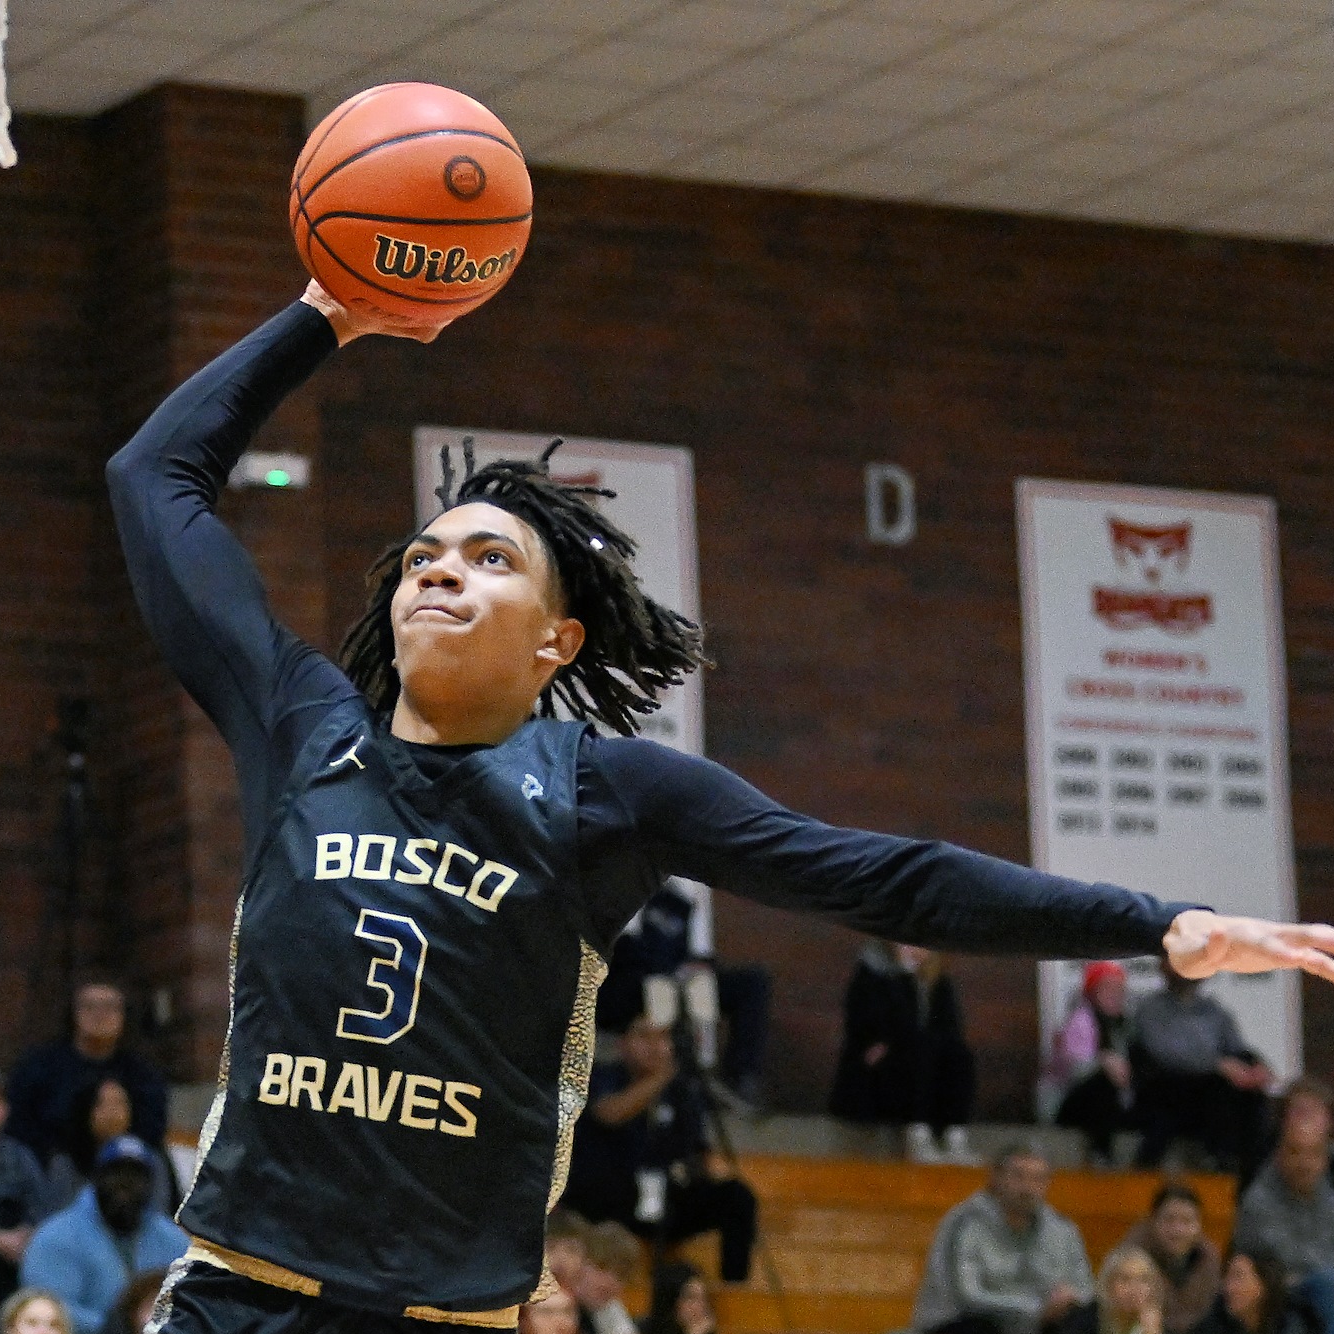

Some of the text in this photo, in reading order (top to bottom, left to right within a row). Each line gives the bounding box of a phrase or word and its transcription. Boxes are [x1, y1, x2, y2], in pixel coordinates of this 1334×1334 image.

[373, 233, 517, 287] Wilson
[863, 463, 917, 546] D
[315, 832, 520, 914] BOSCO
[335, 907, 428, 1046] 3
[258, 1052, 482, 1138] BRAVES
